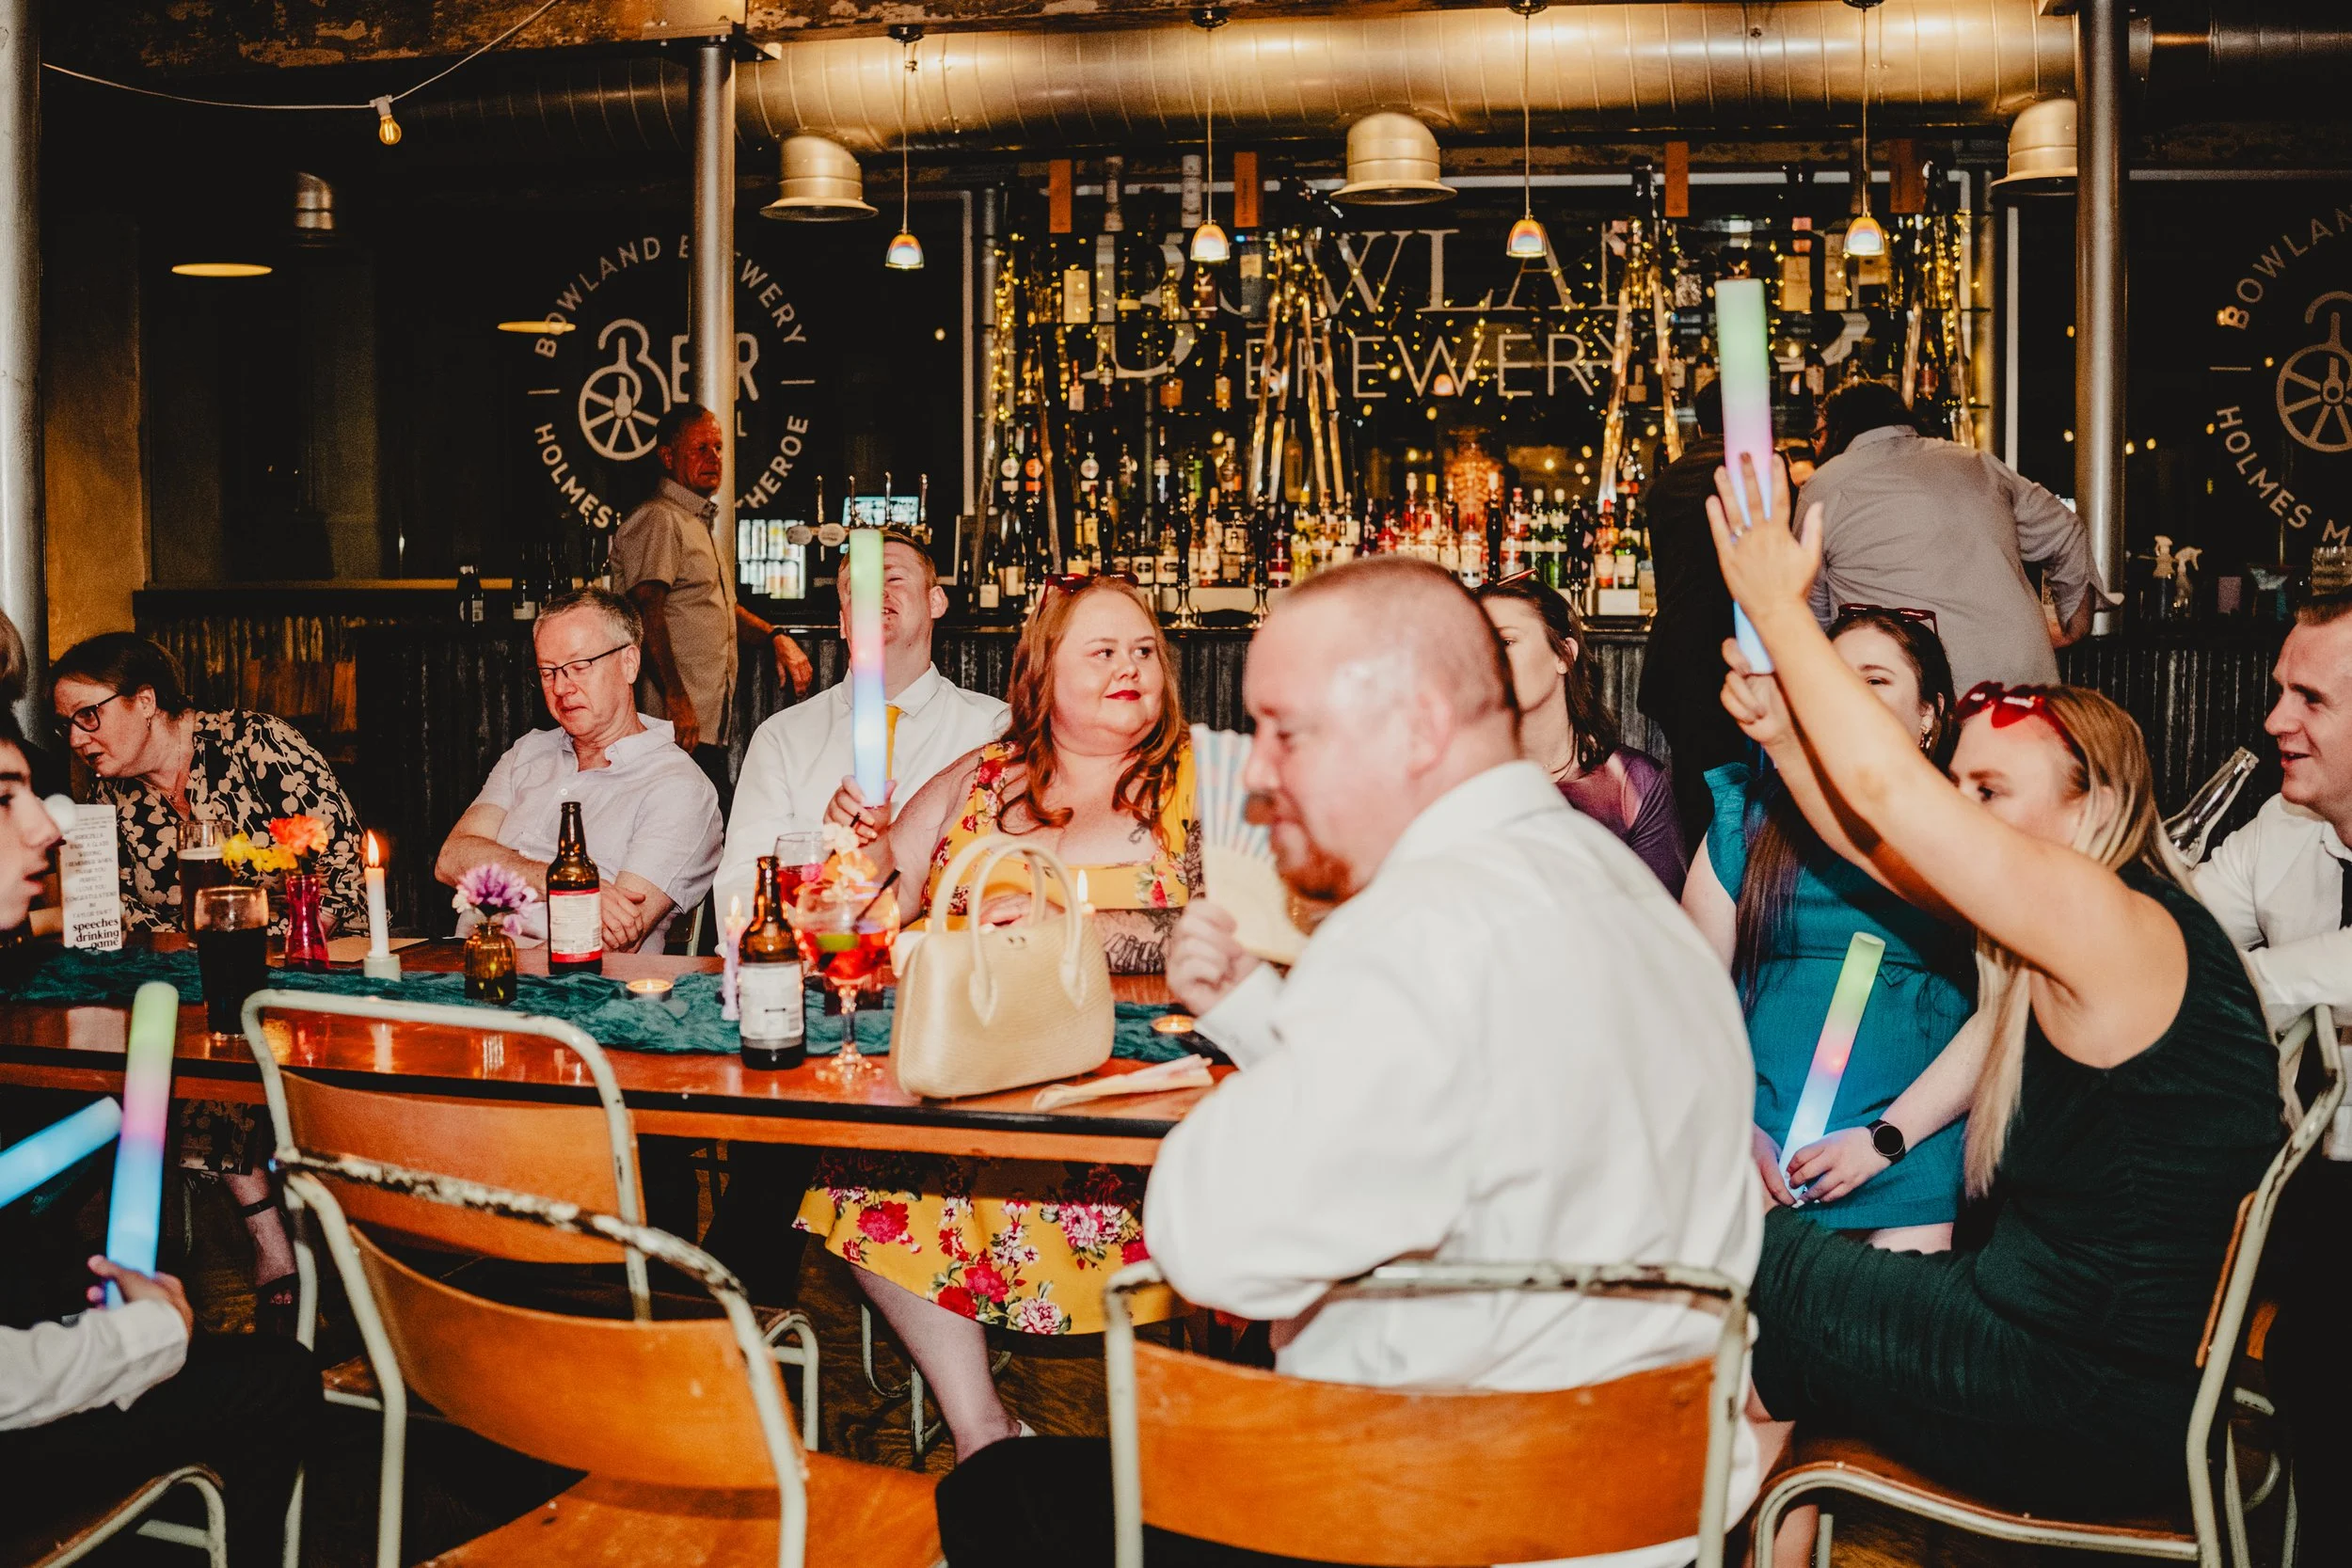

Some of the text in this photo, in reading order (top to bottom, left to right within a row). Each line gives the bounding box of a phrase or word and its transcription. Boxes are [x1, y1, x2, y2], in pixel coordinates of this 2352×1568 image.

[534, 234, 807, 359] BOWLAND BWERY
[534, 422, 614, 529] HOLMES
[2216, 405, 2312, 529] HOLMES
[72, 918, 119, 933] speeches
[76, 929, 119, 943] drinking
